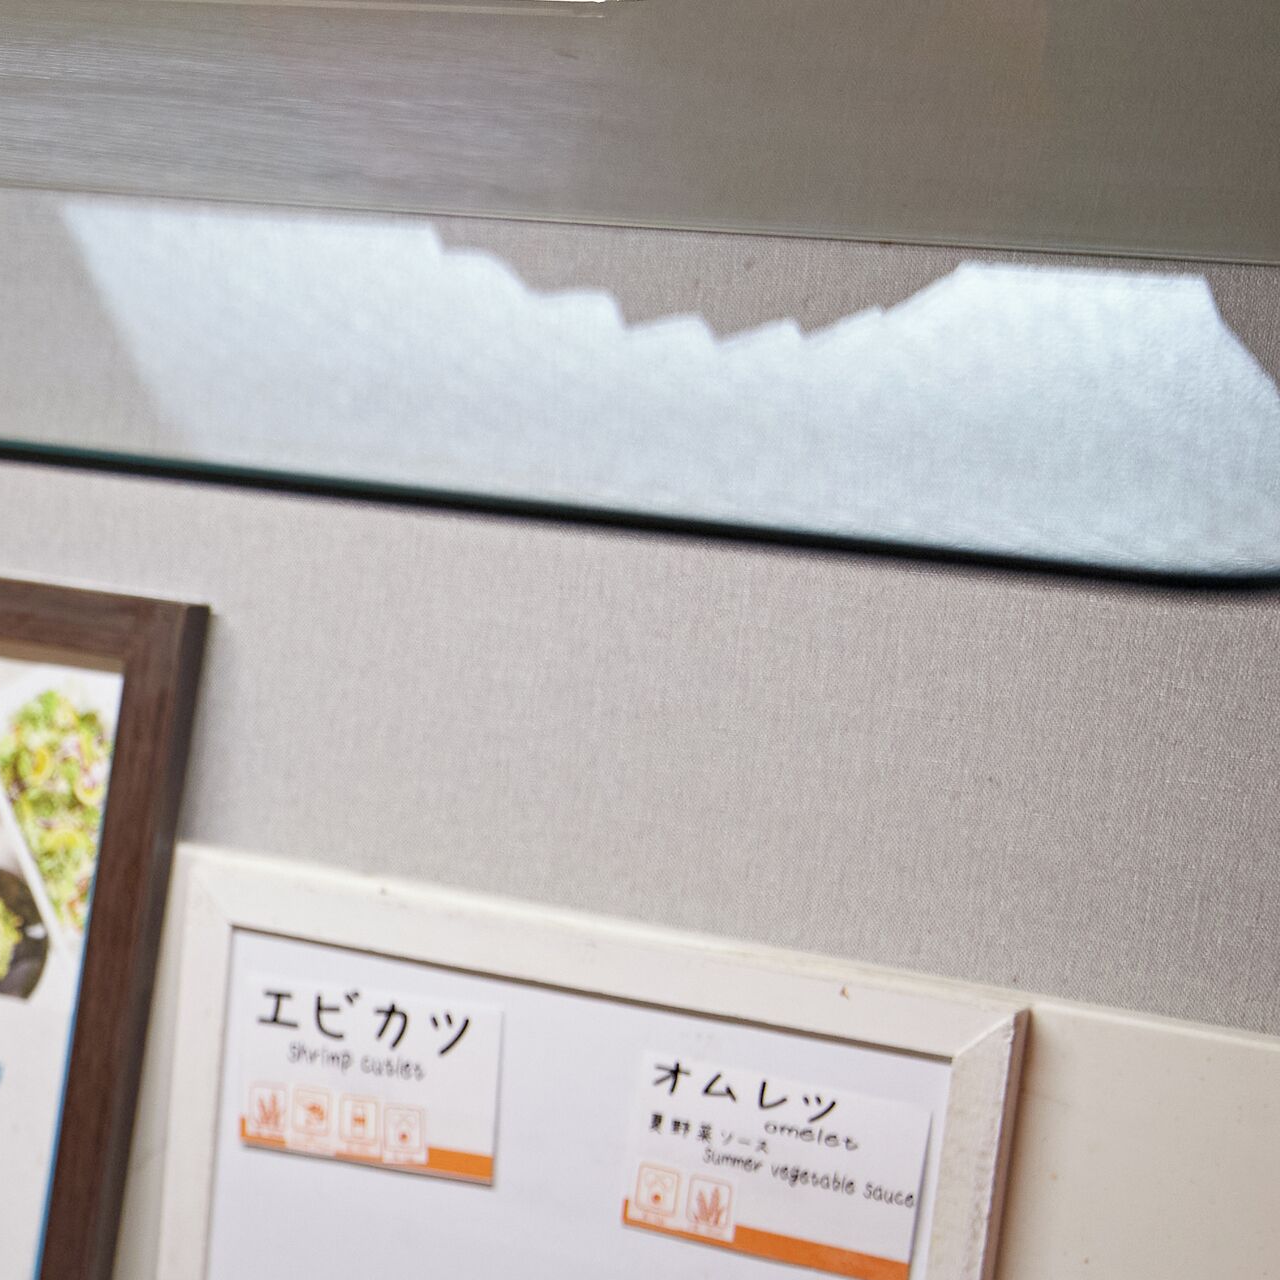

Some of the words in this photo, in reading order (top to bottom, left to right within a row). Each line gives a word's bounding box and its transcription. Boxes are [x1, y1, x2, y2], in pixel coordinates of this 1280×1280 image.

[258, 988, 472, 1057] エビカツ
[652, 1061, 836, 1123] オムレツ
[763, 1120, 860, 1151] omelet
[769, 1160, 857, 1196] vegetable
[862, 1180, 917, 1209] sauce
